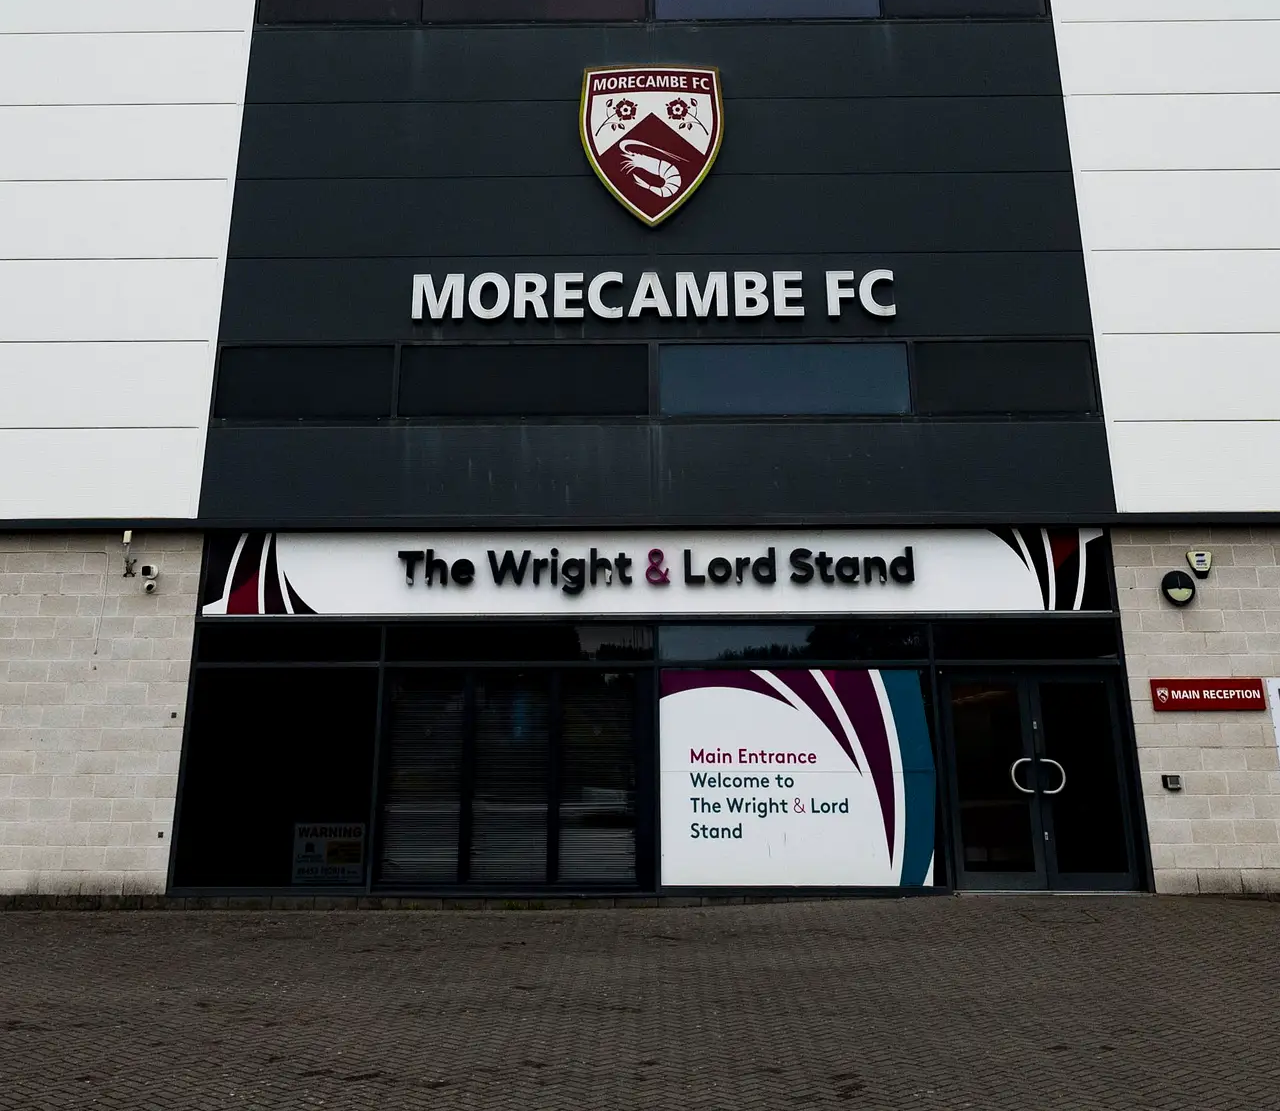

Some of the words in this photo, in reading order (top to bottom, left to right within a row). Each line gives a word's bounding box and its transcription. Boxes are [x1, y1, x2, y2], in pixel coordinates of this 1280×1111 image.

[593, 75, 688, 91] MORECAMBE
[692, 77, 711, 90] FC
[411, 271, 805, 319] MORECAMBE
[826, 269, 897, 317] FC
[397, 548, 475, 586] The
[487, 547, 634, 595] Wright
[645, 548, 671, 585] &
[684, 546, 777, 586] Lord
[789, 546, 916, 585] Stand
[1171, 689, 1200, 699] MAIN
[1202, 689, 1261, 699] RECEPTION
[690, 748, 732, 764] Main
[738, 748, 817, 764] Entrance
[690, 772, 770, 788] Welcome
[775, 774, 794, 788] to
[690, 797, 721, 814] The
[726, 797, 788, 818] Wright
[793, 797, 806, 814] &
[811, 797, 849, 814] Lord
[690, 823, 743, 839] Stand
